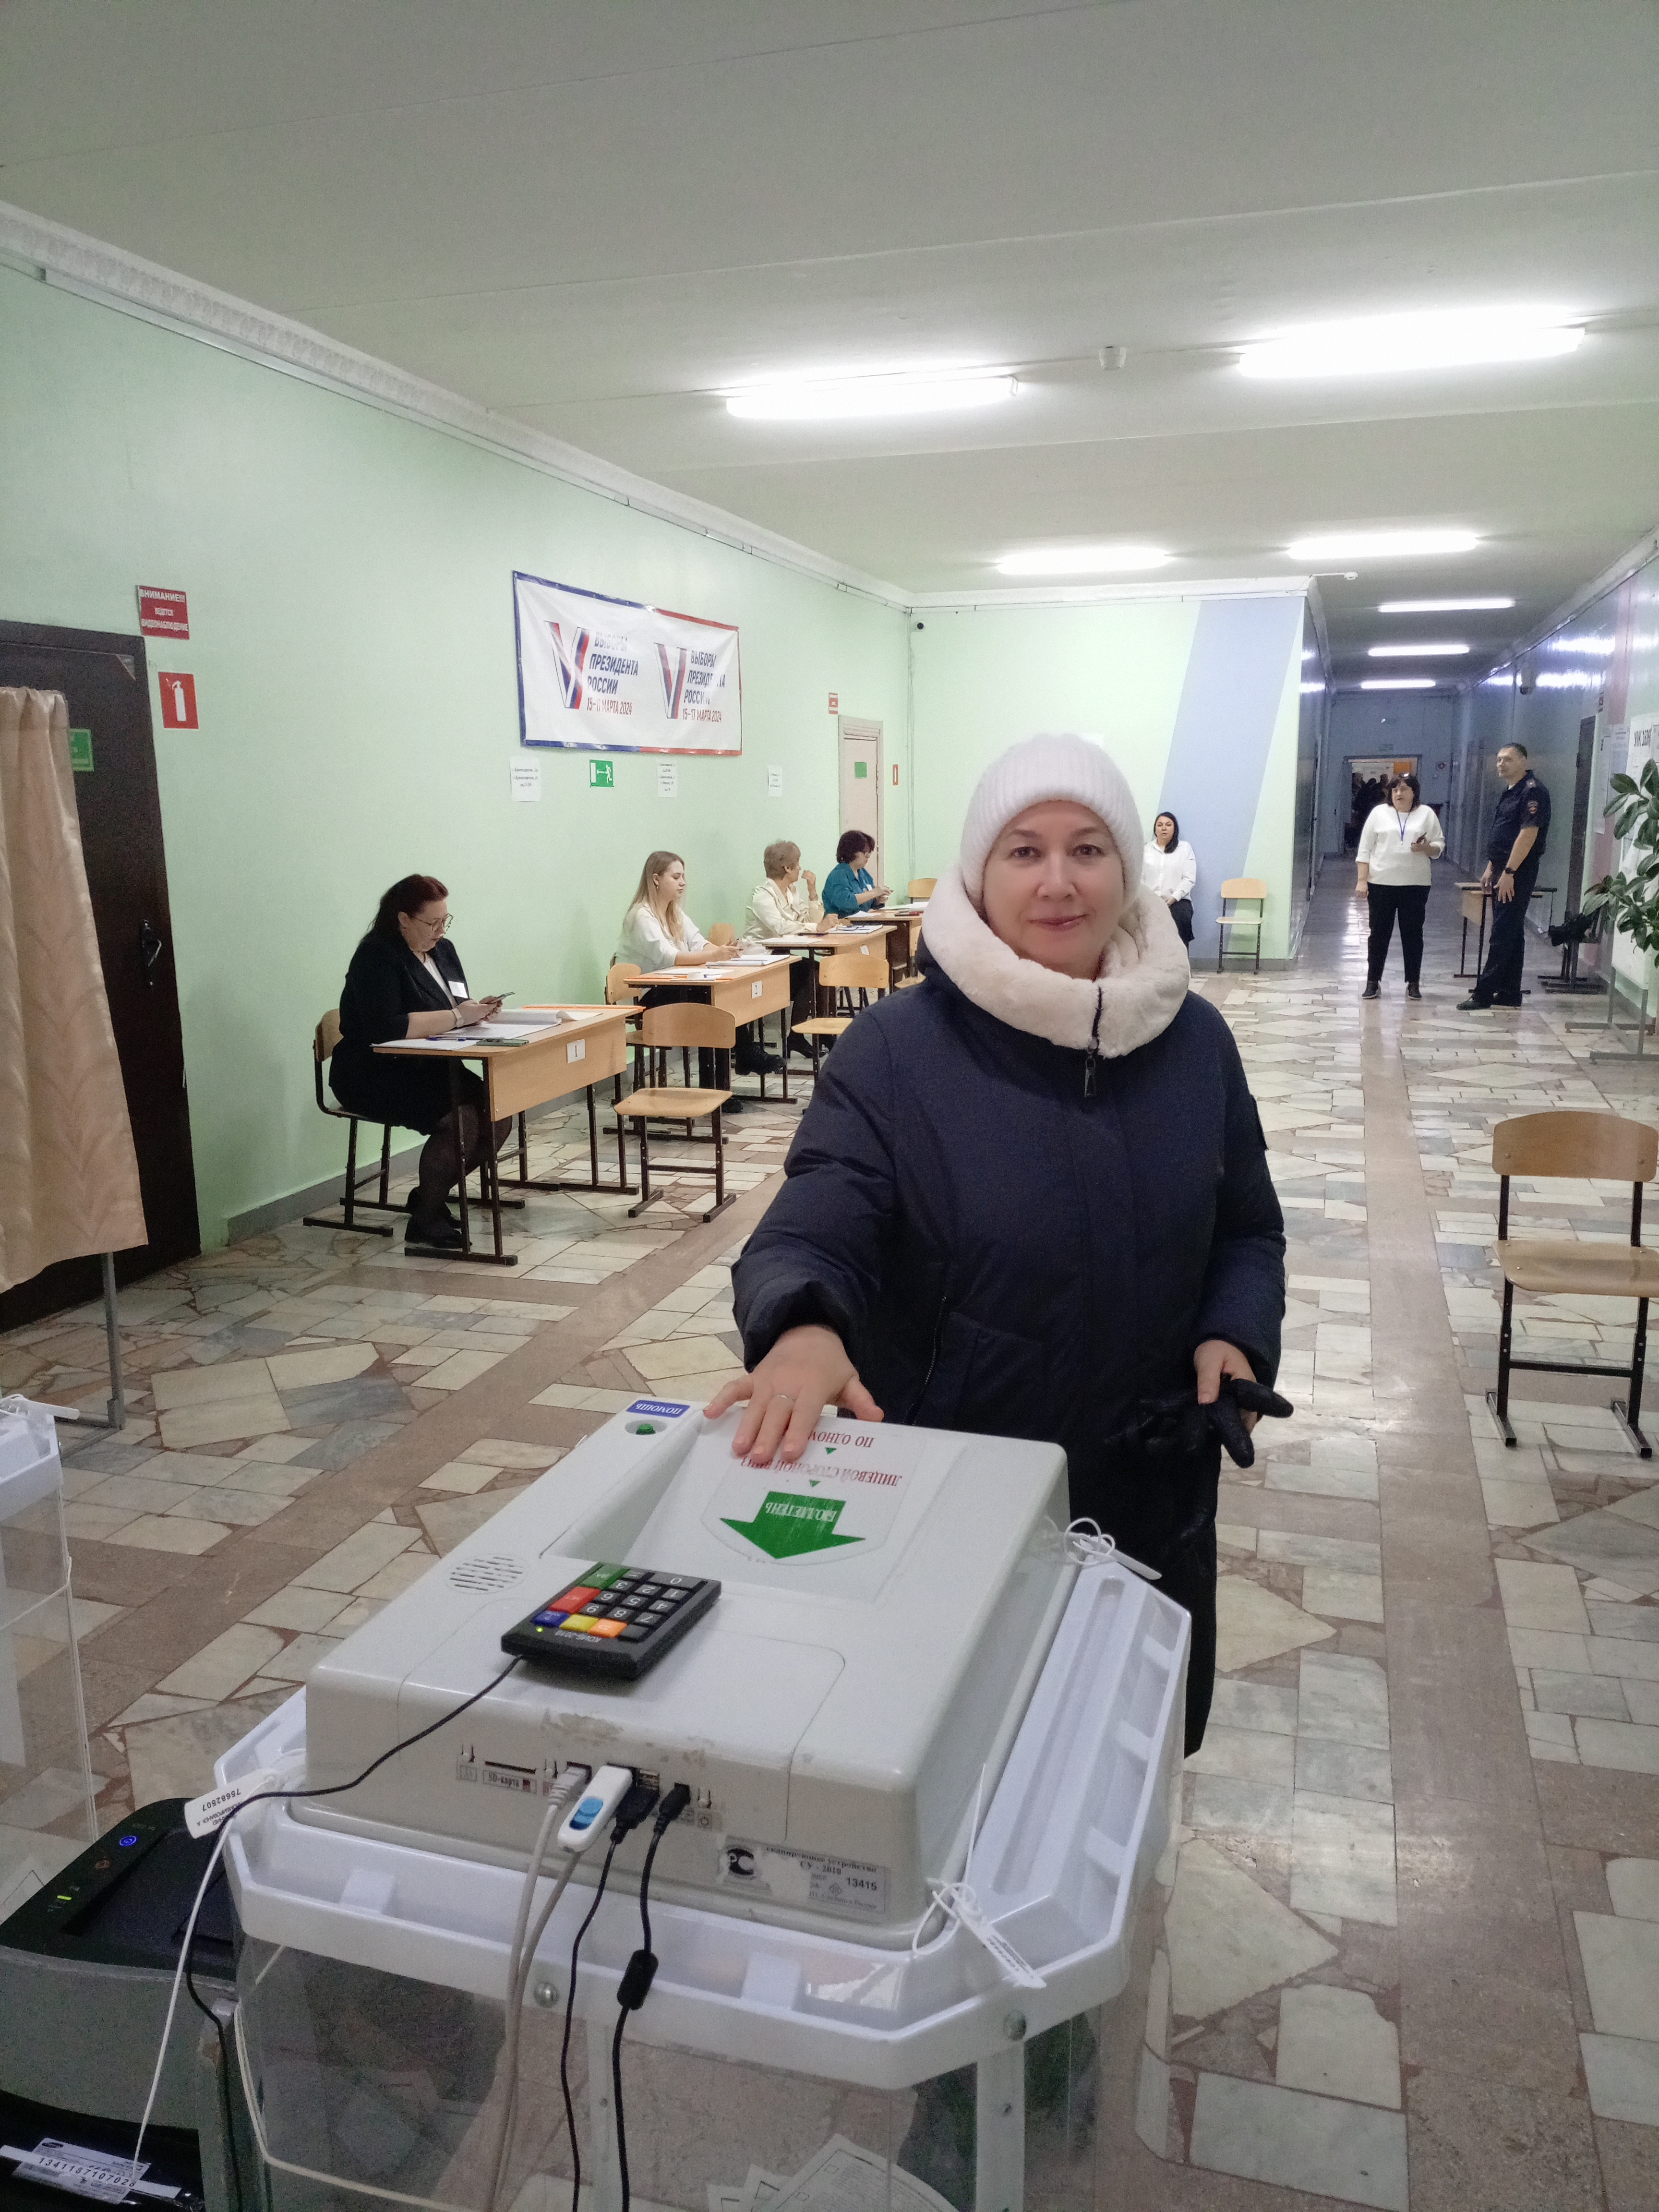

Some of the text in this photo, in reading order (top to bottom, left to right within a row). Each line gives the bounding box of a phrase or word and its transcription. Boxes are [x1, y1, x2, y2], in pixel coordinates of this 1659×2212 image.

[589, 654, 638, 676] ПРЕЗИДЕНТА
[691, 650, 717, 668] ВЫБОРЫ
[588, 676, 618, 695] РОССИИ
[687, 670, 725, 688] ПРЕЗИДА
[602, 700, 618, 714] МАРТА
[620, 701, 632, 715] 2024
[855, 1436, 875, 1448] ПО
[842, 1469, 902, 1487] ЛИЦЕВОЙ
[203, 1789, 241, 1812] 75682507
[847, 1876, 878, 1891] 13415
